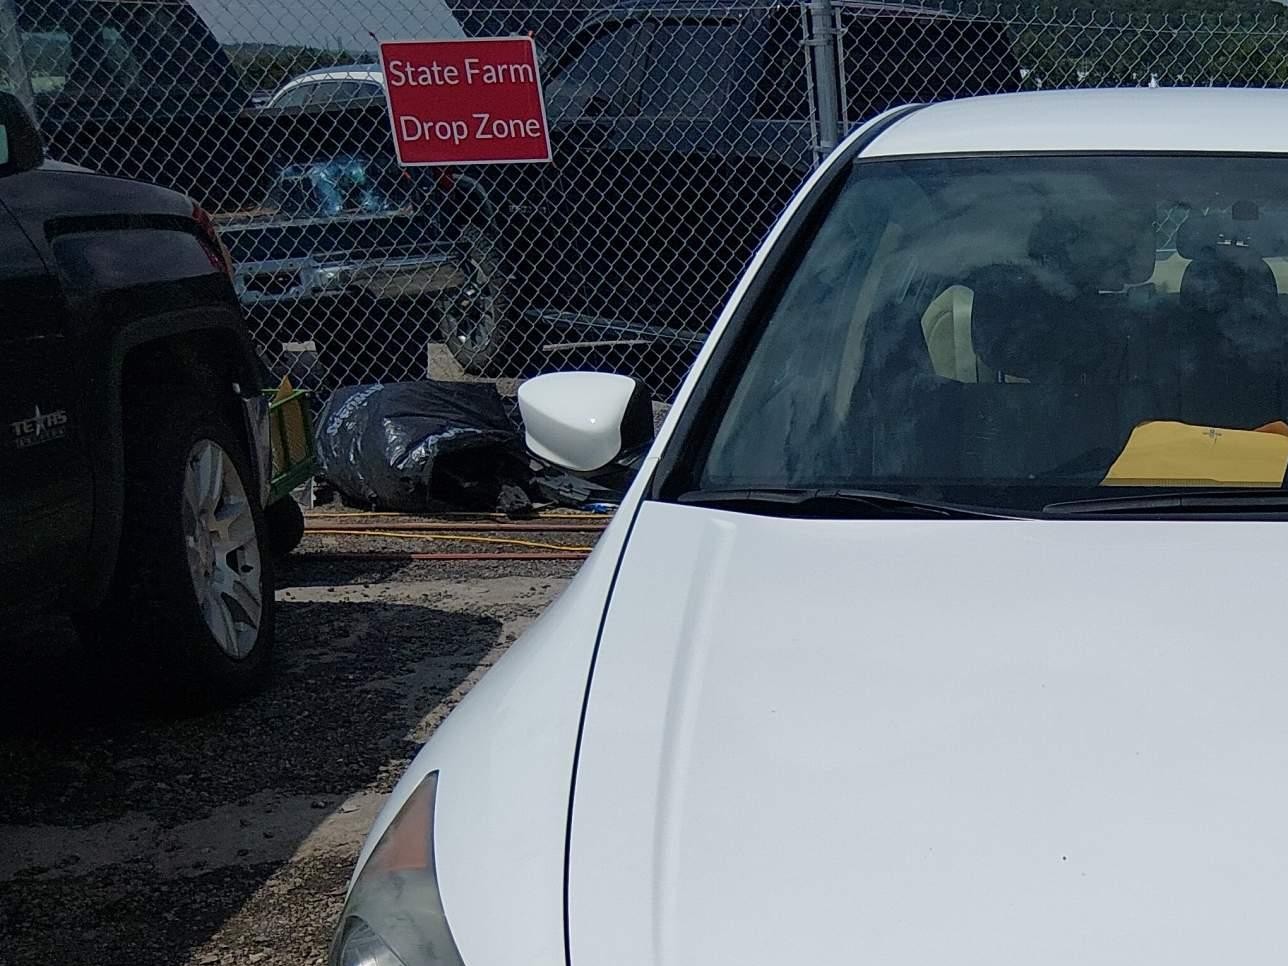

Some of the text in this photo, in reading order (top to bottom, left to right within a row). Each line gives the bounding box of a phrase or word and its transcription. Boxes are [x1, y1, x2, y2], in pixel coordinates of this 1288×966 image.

[389, 58, 534, 86] State Farm
[400, 113, 541, 144] Drop Zone
